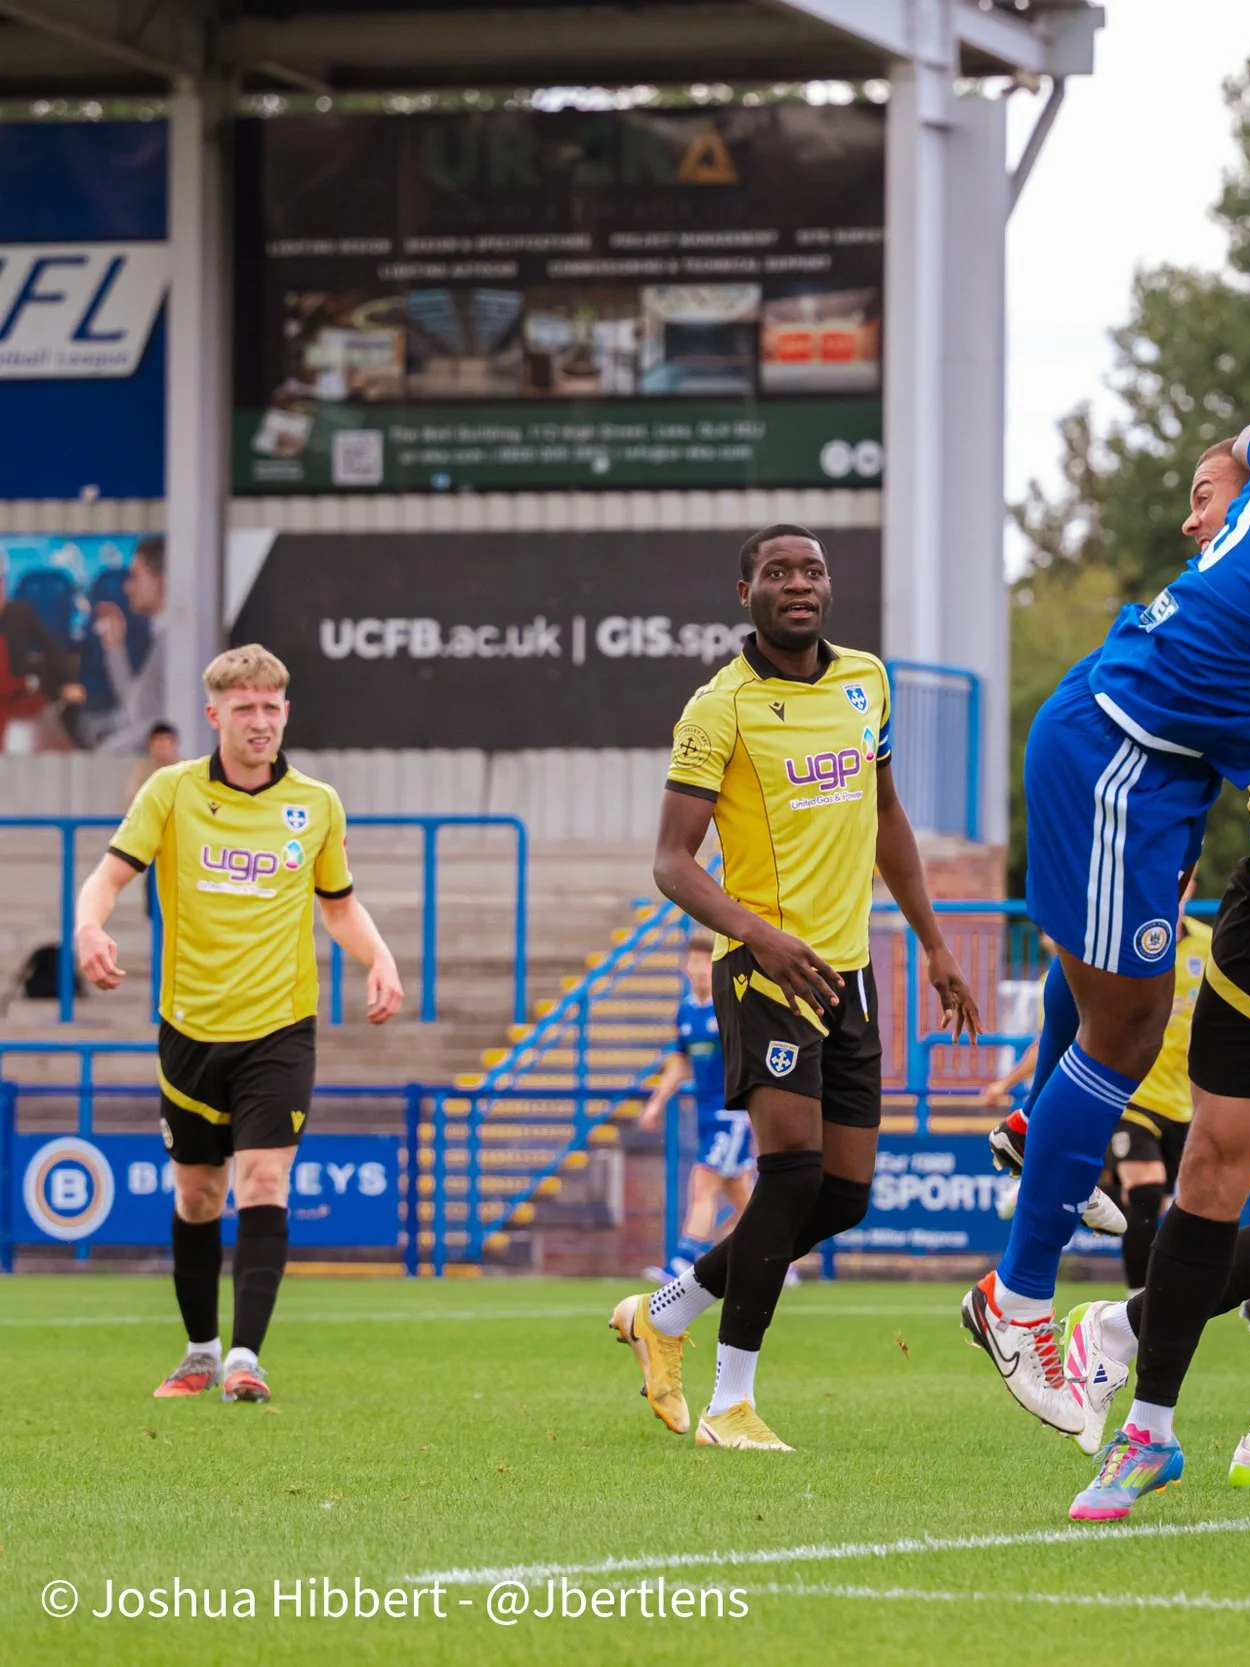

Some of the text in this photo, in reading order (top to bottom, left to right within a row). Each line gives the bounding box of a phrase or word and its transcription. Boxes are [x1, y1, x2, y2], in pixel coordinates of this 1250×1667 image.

[0, 253, 128, 345] FL
[319, 616, 562, 659] UCFB.ac.uk
[596, 615, 756, 665] GIS.spo
[786, 749, 860, 791] ugp
[791, 797, 816, 809] United
[816, 795, 834, 804] Gas
[203, 846, 278, 882] ugp
[52, 1169, 87, 1208] B
